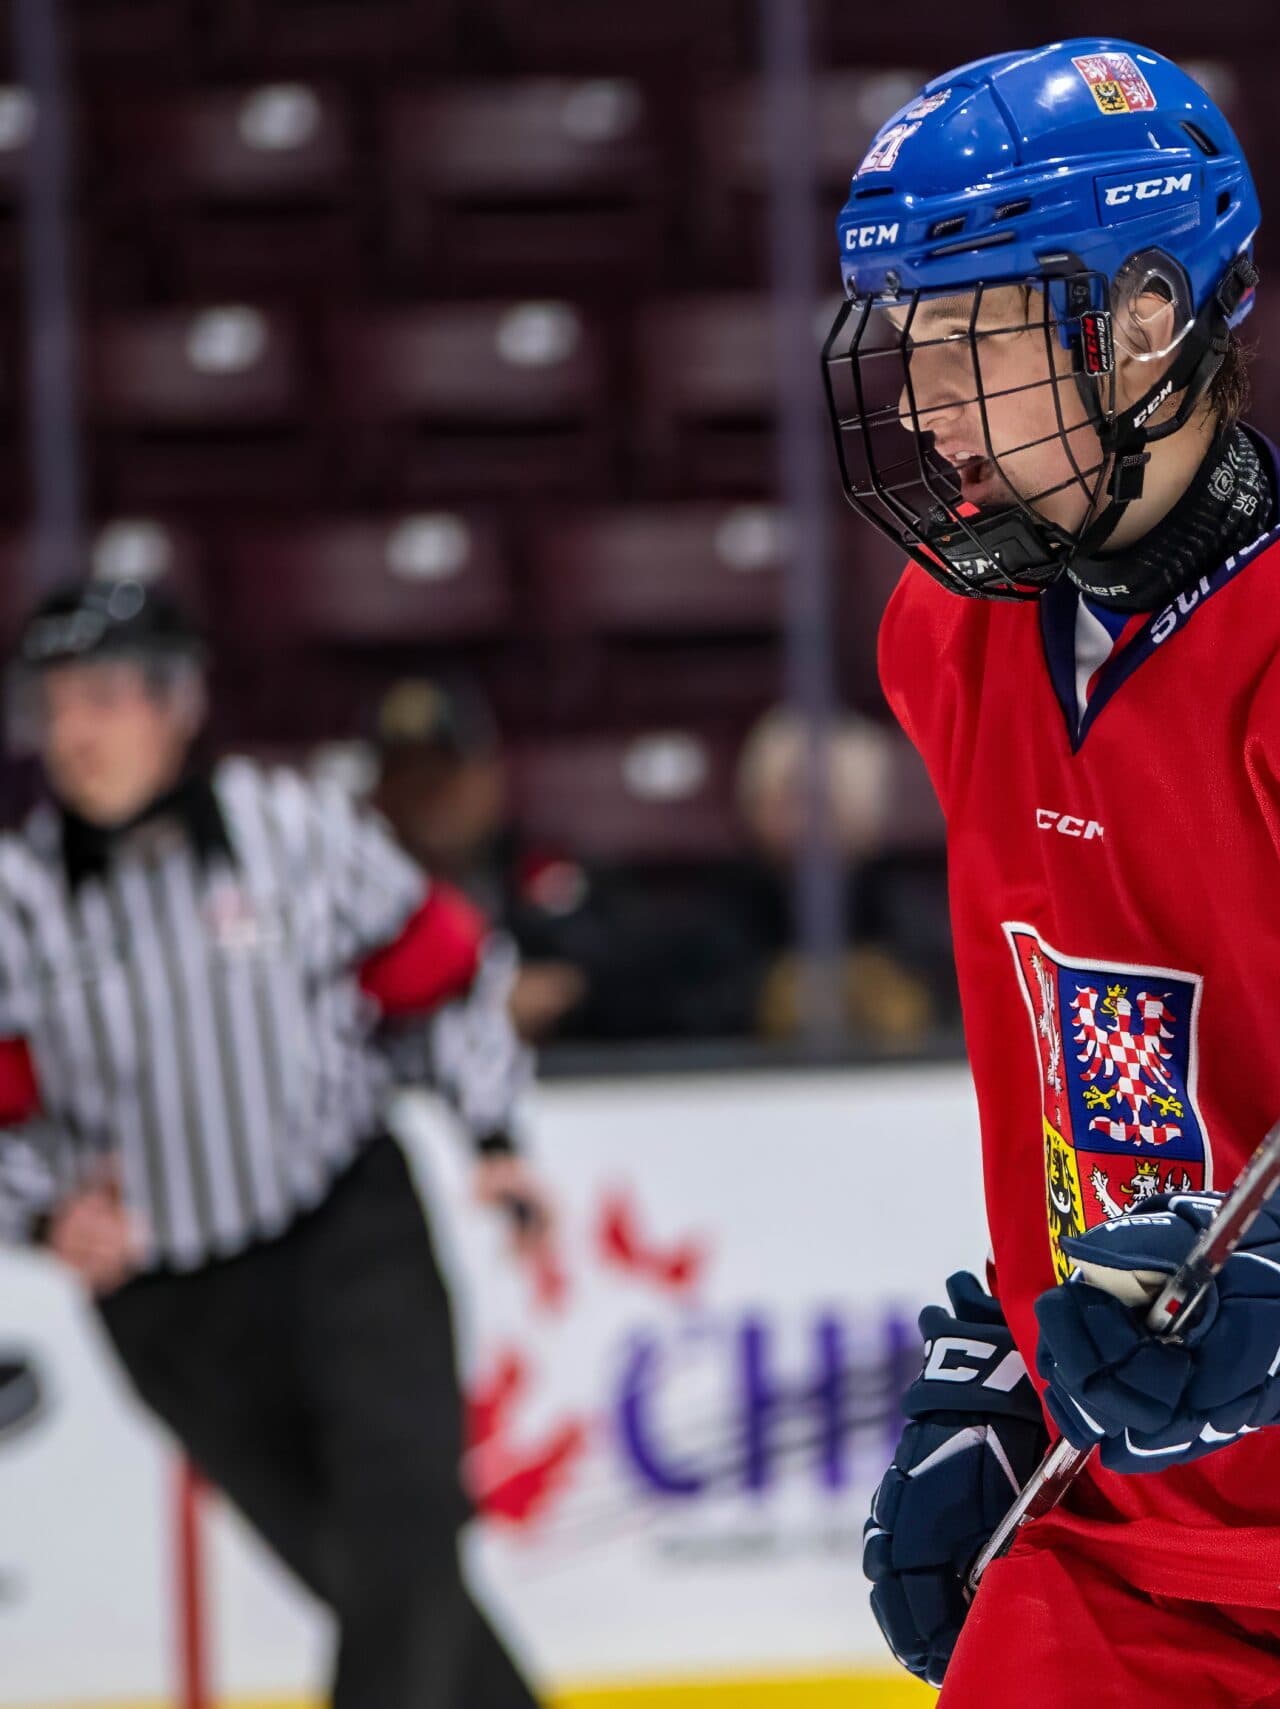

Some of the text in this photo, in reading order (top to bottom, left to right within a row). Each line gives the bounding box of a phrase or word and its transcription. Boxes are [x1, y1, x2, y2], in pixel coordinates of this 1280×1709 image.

[1105, 173, 1192, 206] CCM
[845, 223, 899, 250] CCM
[1133, 380, 1173, 428] CCM
